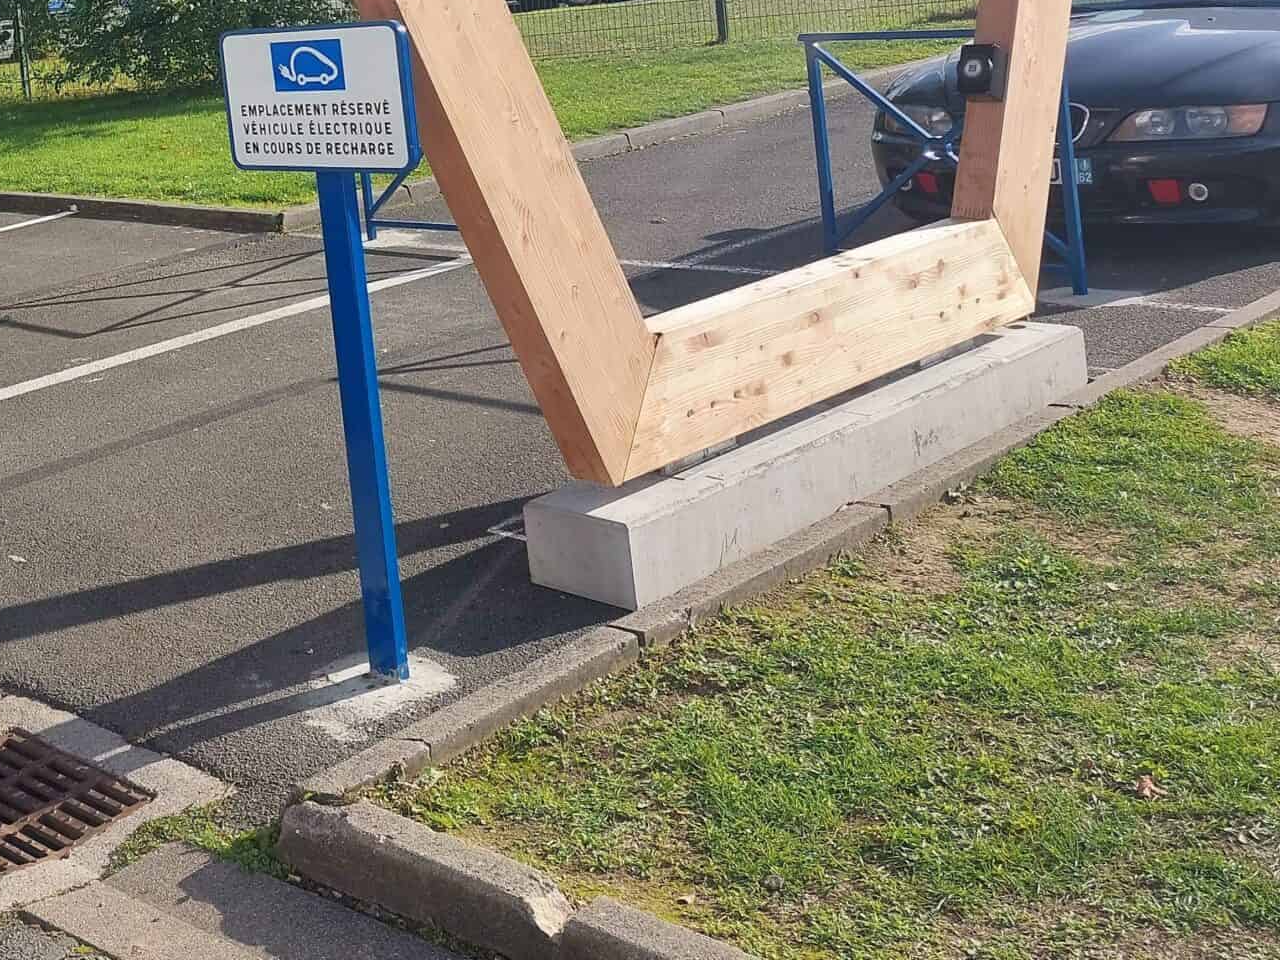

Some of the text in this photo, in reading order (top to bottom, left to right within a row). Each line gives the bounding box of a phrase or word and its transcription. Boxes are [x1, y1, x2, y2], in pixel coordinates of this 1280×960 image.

[241, 99, 391, 117] EMPLACEMENT RÉSERVÉ
[243, 120, 393, 136] VÉHICULE ÉLECTRIQUE
[245, 142, 395, 156] EN COURS DE RECHARGE
